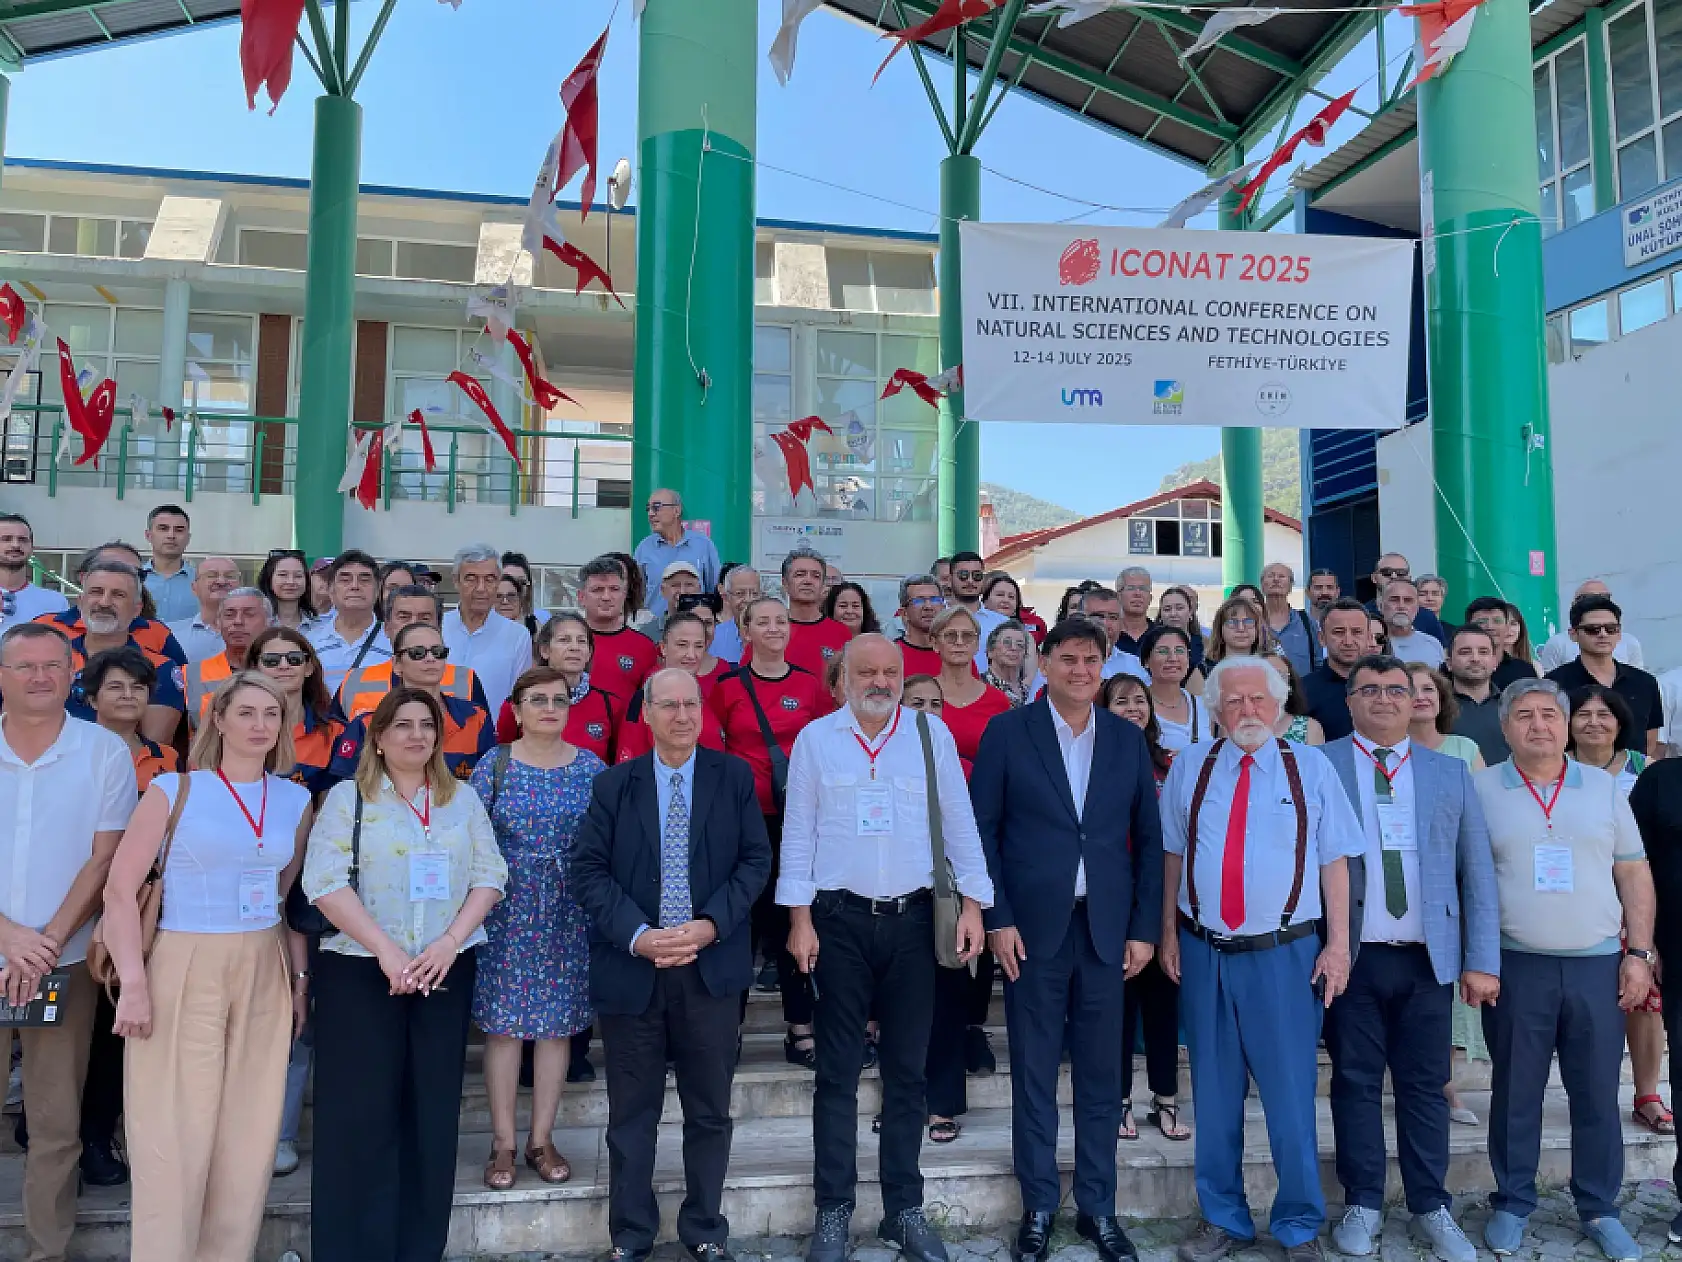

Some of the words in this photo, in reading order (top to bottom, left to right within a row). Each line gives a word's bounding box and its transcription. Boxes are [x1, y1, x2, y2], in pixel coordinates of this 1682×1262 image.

[1110, 247, 1234, 281] ICONAT
[1239, 253, 1311, 284] 2025
[987, 292, 1025, 311] VII.
[1032, 294, 1199, 316] INTERNATIONAL
[1205, 301, 1339, 321] CONFERENCE
[1346, 304, 1377, 321] ON
[976, 318, 1066, 339] NATURAL
[1072, 322, 1171, 342] SCIENCES
[1177, 325, 1220, 343] AND
[1227, 327, 1390, 347] TECHNOLOGIES
[1013, 350, 1055, 364] 12-14
[1058, 351, 1092, 365] JULY
[1096, 352, 1133, 367] 2025
[1208, 353, 1348, 371] FETHİYE-TÜRKİYE
